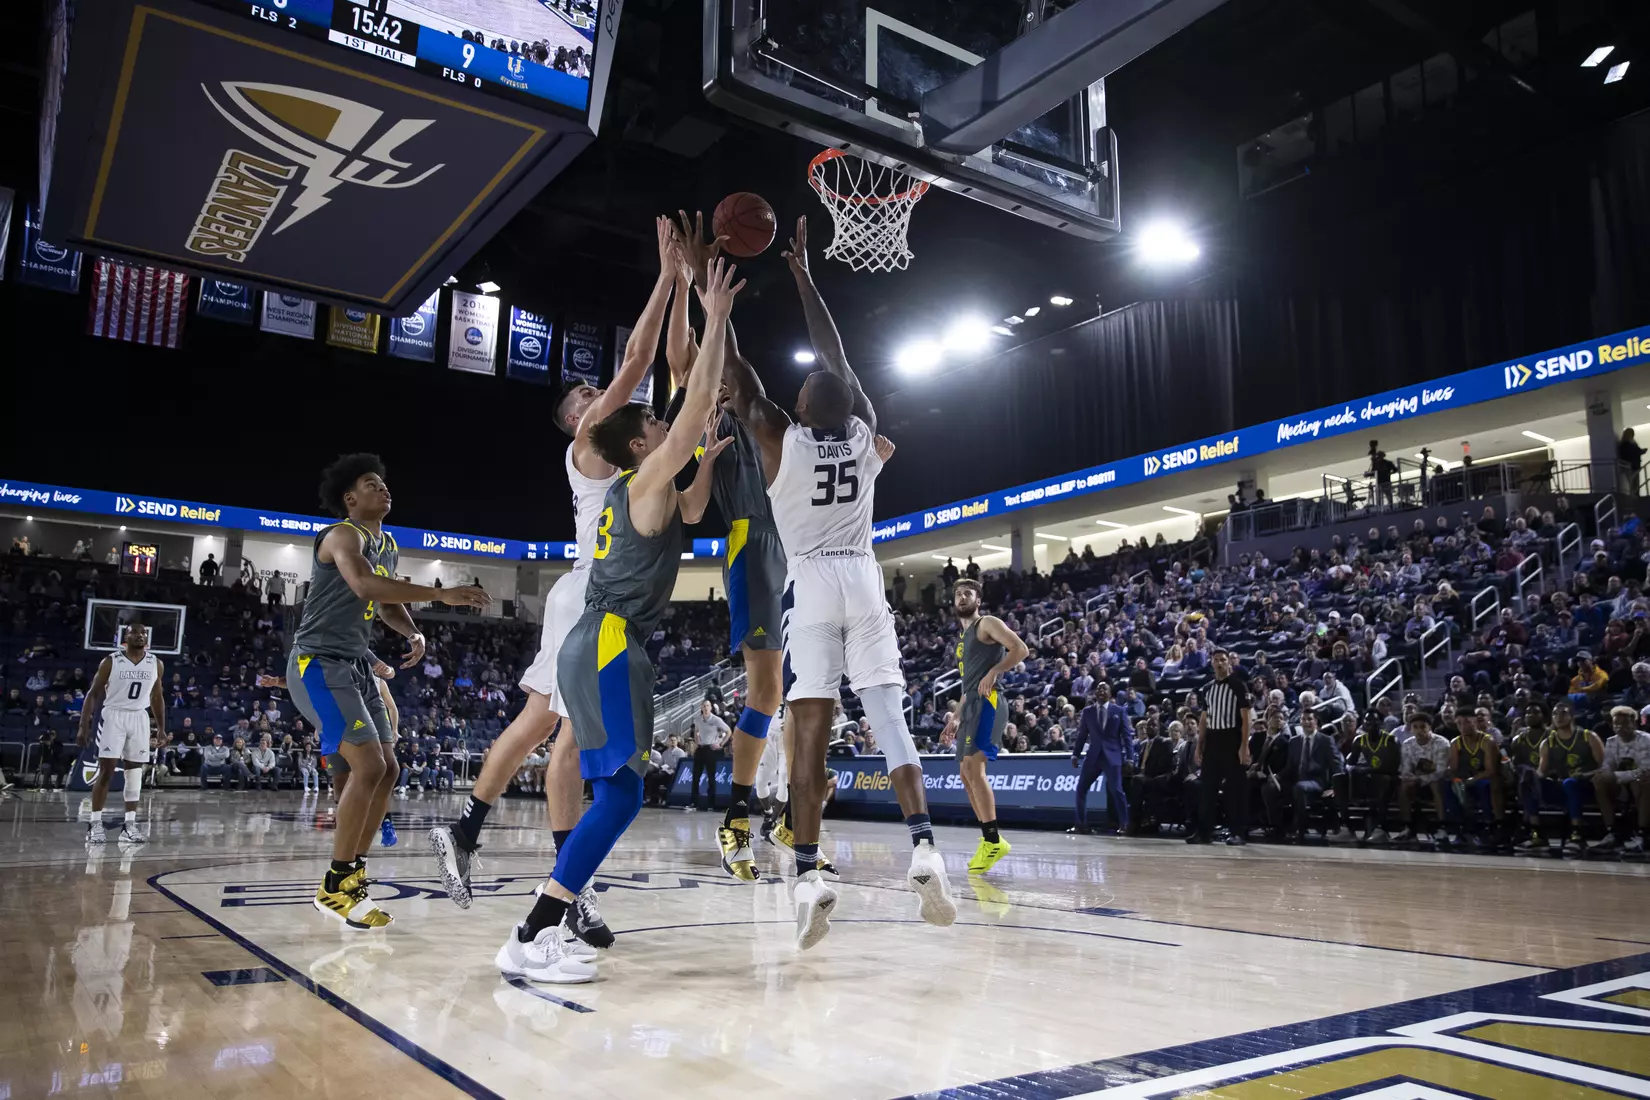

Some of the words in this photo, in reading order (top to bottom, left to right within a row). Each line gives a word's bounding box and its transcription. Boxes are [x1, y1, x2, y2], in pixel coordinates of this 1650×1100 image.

[251, 5, 278, 22] FLS
[288, 17, 297, 29] 2
[352, 7, 402, 44] 15:42
[344, 36, 367, 50] 1ST
[375, 46, 407, 62] HALF
[462, 44, 475, 69] 9
[443, 67, 466, 83] FLS
[474, 77, 482, 88] 0
[185, 149, 298, 263] LANCERS
[20, 259, 77, 277] CHAMPIONS
[202, 294, 252, 310] CHAMPIONS
[266, 307, 286, 316] WEST
[286, 310, 313, 321] REGION
[267, 313, 310, 327] CHAMPIONS
[345, 309, 367, 319] NCAA
[454, 315, 496, 329] BASKETBALL
[519, 310, 545, 323] 2017
[333, 322, 368, 333] DIVISION
[511, 324, 551, 340] BASKETBALL
[515, 318, 547, 331] WOMEN'S
[573, 322, 598, 335] 2017
[330, 335, 363, 347] RUNNER
[333, 329, 373, 341] NATIONAL
[390, 335, 433, 349] CHAMPIONS
[465, 334, 482, 342] NCAA
[451, 351, 493, 364] TOURNAMENT
[457, 346, 483, 357] DIVISION
[1535, 350, 1594, 380] SEND
[1598, 336, 1650, 365] Relie
[509, 358, 549, 371] CHAMPIONS
[1277, 420, 1322, 443] Meeting
[1324, 406, 1357, 428] needs,
[1361, 395, 1418, 420] changing
[1422, 386, 1456, 406] lives
[817, 442, 852, 459] DAVIS
[1162, 448, 1198, 470] SEND
[1199, 436, 1239, 461] Relief
[811, 459, 859, 506] 35
[53, 490, 82, 504] lives
[1004, 494, 1020, 506] Text
[1020, 488, 1045, 503] SEND
[1045, 480, 1076, 497] RELIEF
[1076, 478, 1087, 490] to
[138, 500, 178, 517] SEND
[179, 505, 221, 522] Relief
[936, 507, 961, 524] SEND
[961, 499, 989, 518] Relief
[259, 516, 281, 528] Text
[281, 519, 312, 531] SEND
[128, 545, 157, 558] 15:42
[440, 535, 471, 550] SEND
[473, 540, 506, 554] Relief
[711, 540, 720, 556] 9
[820, 548, 855, 557] LanceUp
[544, 552, 549, 560] 2
[134, 556, 151, 574] 11
[119, 670, 151, 681] LANCERS
[128, 681, 143, 700] 0
[922, 774, 944, 789] Text
[1036, 776, 1051, 791] to
